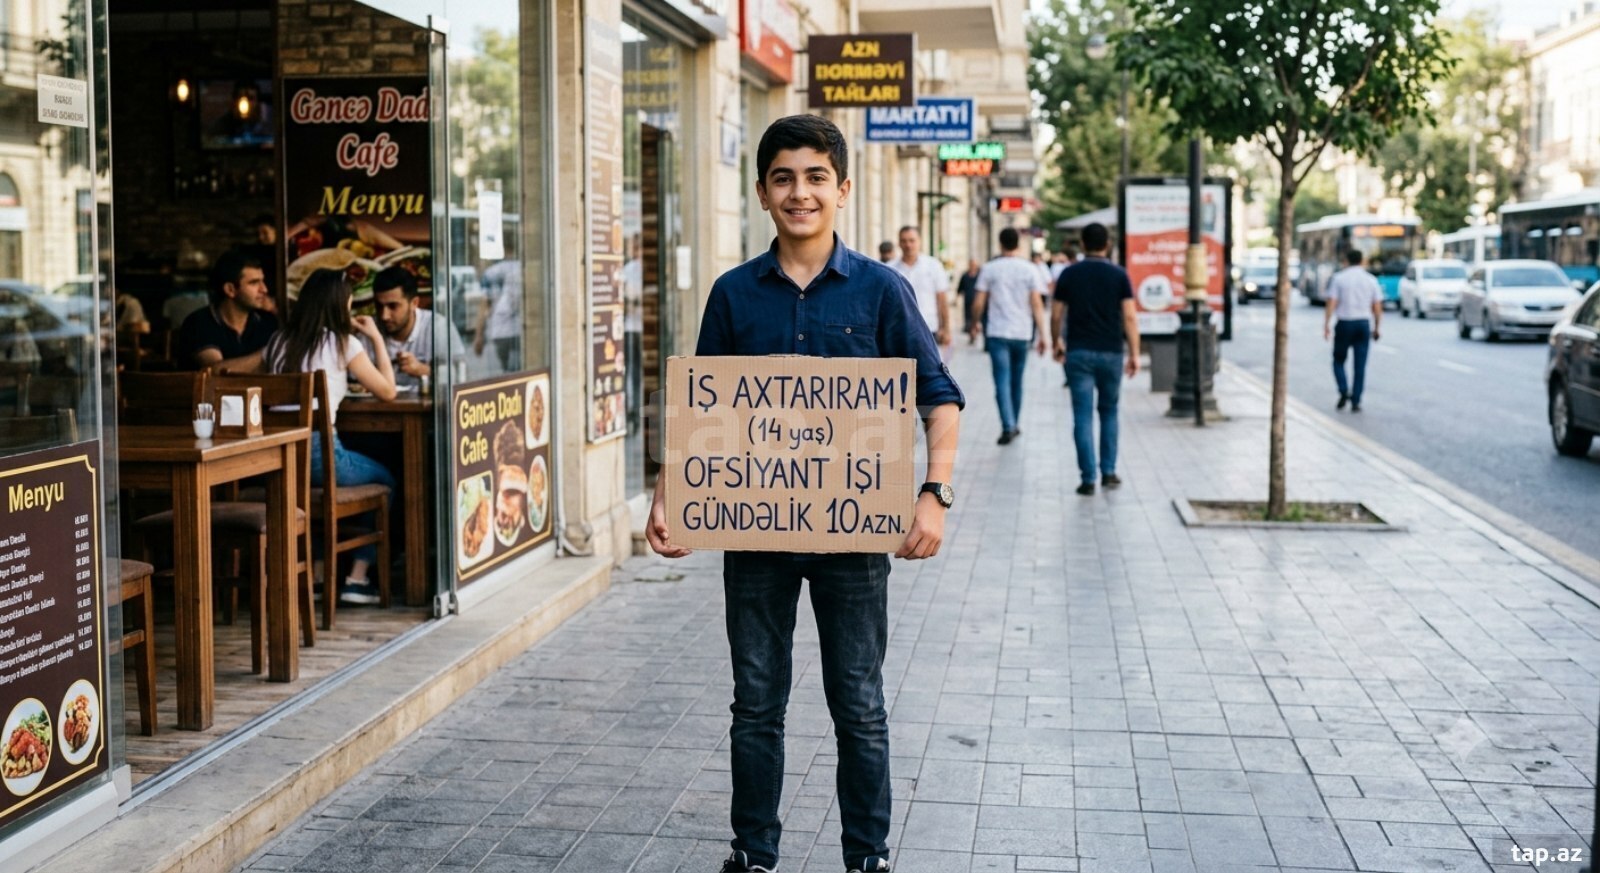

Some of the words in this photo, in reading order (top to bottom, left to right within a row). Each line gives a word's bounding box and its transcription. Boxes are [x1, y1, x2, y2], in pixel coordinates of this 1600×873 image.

[841, 41, 880, 57] AZN
[291, 88, 373, 124] Gəncə
[336, 132, 399, 177] Cafe
[317, 186, 424, 222] Menyu
[688, 368, 718, 413] İŞ
[732, 371, 909, 414] AXTARIRAM!
[460, 431, 488, 466] Cafe
[748, 416, 782, 446] (14
[789, 416, 834, 450] yaş)
[684, 451, 830, 490] OFSİYANT
[846, 452, 881, 494] İŞİ
[8, 481, 64, 513] Menyu
[683, 497, 813, 532] GÜNDƏLİK
[826, 498, 860, 534] 10
[861, 514, 906, 534] AZN.
